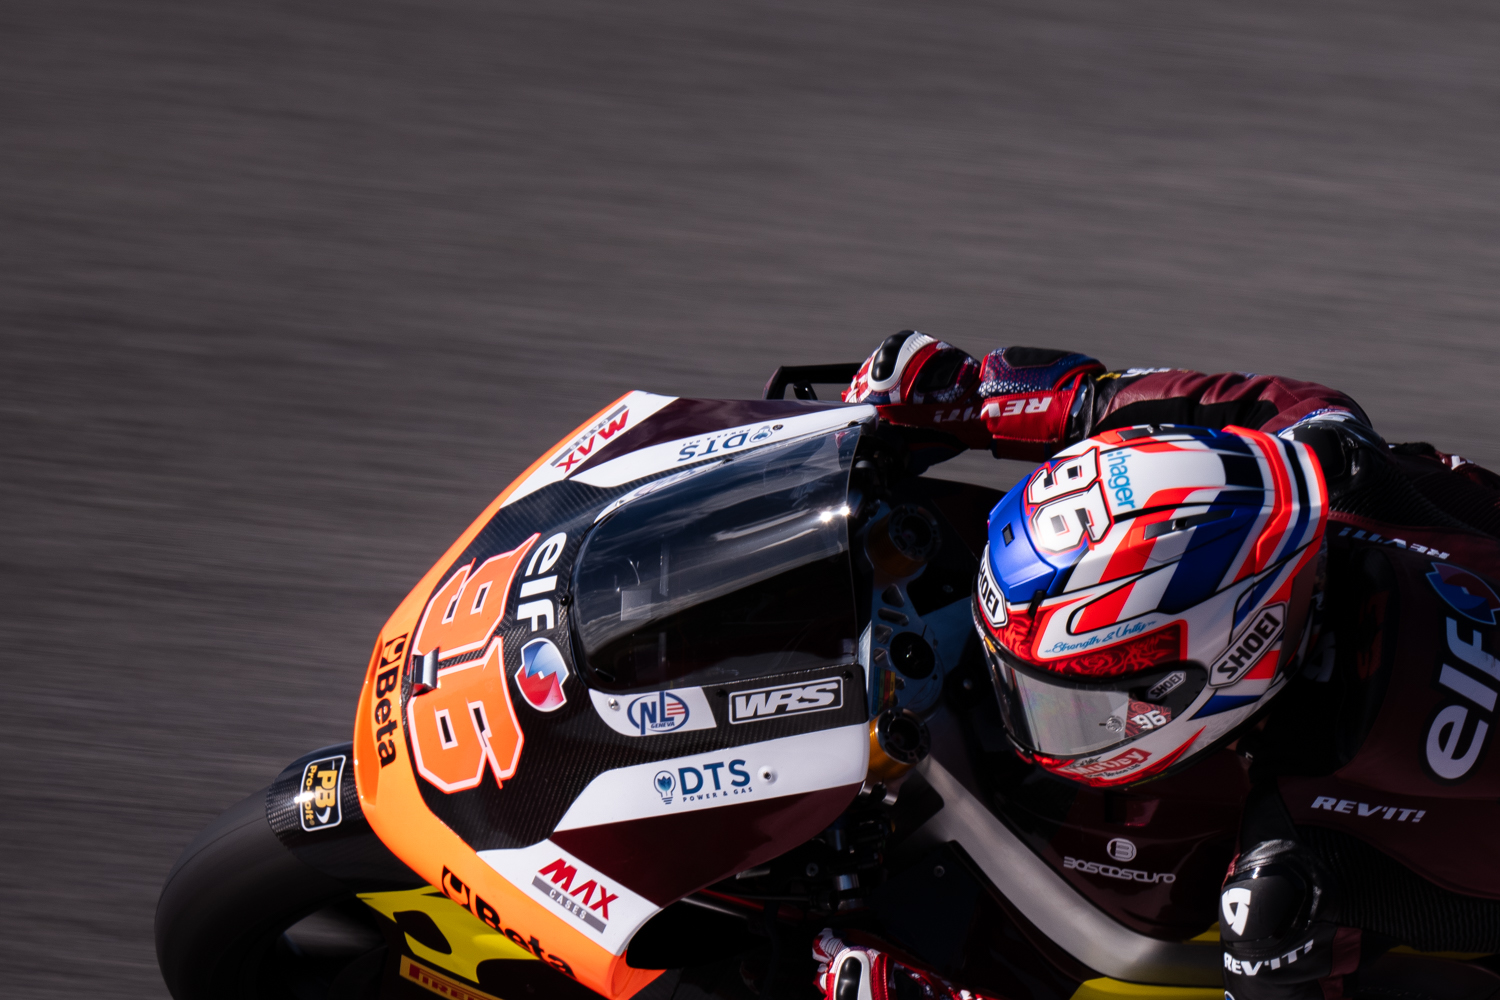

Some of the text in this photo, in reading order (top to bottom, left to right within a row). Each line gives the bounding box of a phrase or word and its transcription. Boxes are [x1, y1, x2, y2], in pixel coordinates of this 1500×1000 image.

[555, 409, 629, 473] MAX
[677, 433, 748, 462] DTS
[1023, 446, 1115, 556] 96
[516, 532, 567, 632] elf
[980, 555, 1000, 619] HOEI
[1052, 621, 1146, 653] Strength & Unity
[1217, 612, 1281, 680] SHOEI
[407, 532, 541, 794] 96
[735, 681, 839, 719] WRS
[1150, 673, 1182, 697] SHOEI
[374, 664, 400, 769] Beta
[650, 721, 675, 729] GENEVA
[1131, 709, 1167, 730] 96
[315, 769, 338, 808] PB
[678, 759, 750, 796] DTS
[683, 792, 717, 803] POWER
[733, 786, 753, 794] GAS
[1310, 795, 1427, 823] REV'IT!
[538, 858, 618, 920] MAX
[549, 888, 586, 920] CASES
[1223, 939, 1314, 977] REV'IT!
